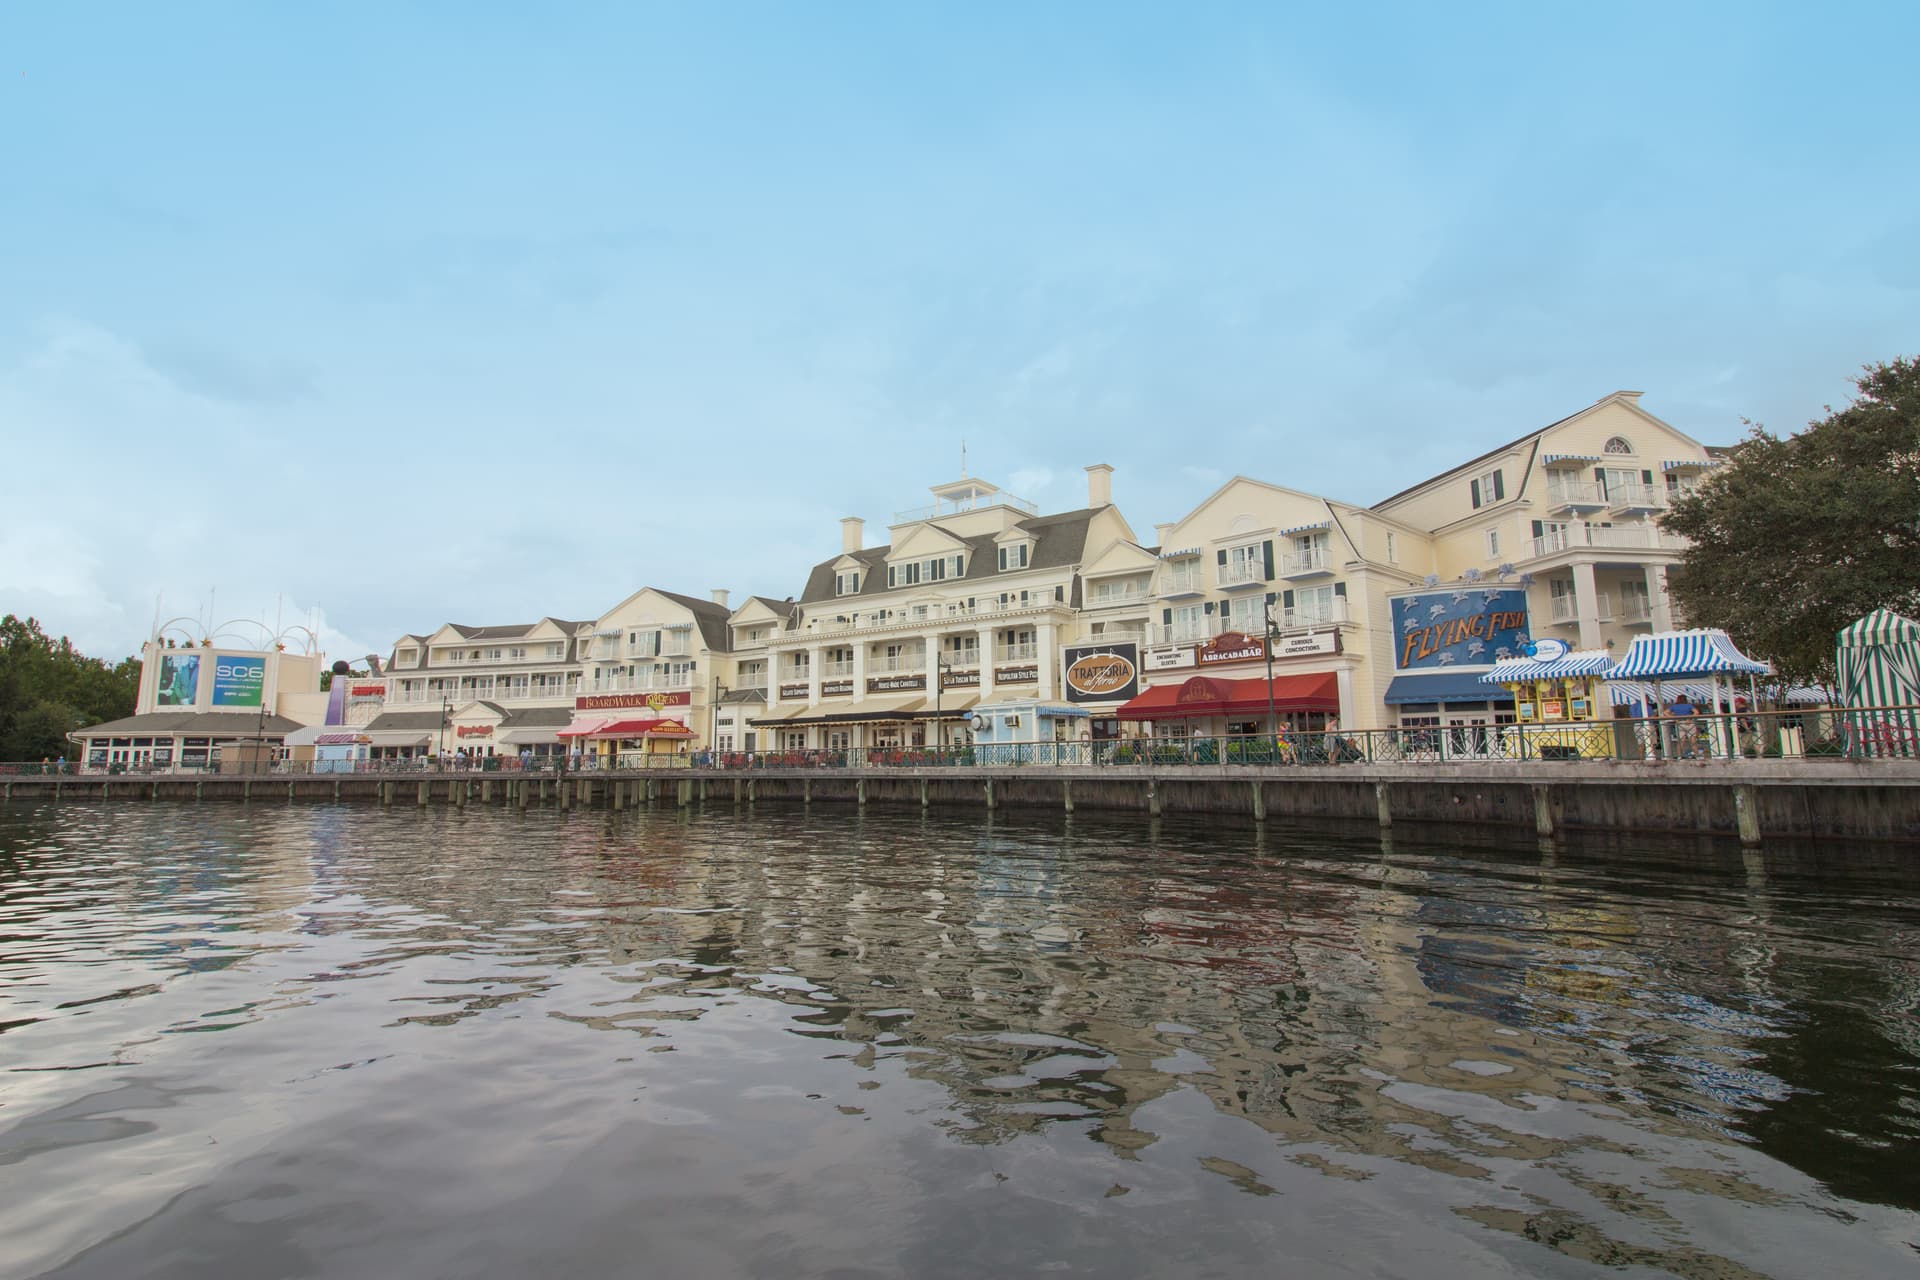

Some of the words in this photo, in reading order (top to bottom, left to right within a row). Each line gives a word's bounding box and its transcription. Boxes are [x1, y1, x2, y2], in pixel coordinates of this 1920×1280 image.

[1402, 614, 1484, 668] FLYING
[1485, 611, 1525, 641] FISH
[1285, 645, 1320, 653] CONCOCTIONS
[216, 665, 263, 678] SC6
[1073, 664, 1130, 680] TRATTORIA
